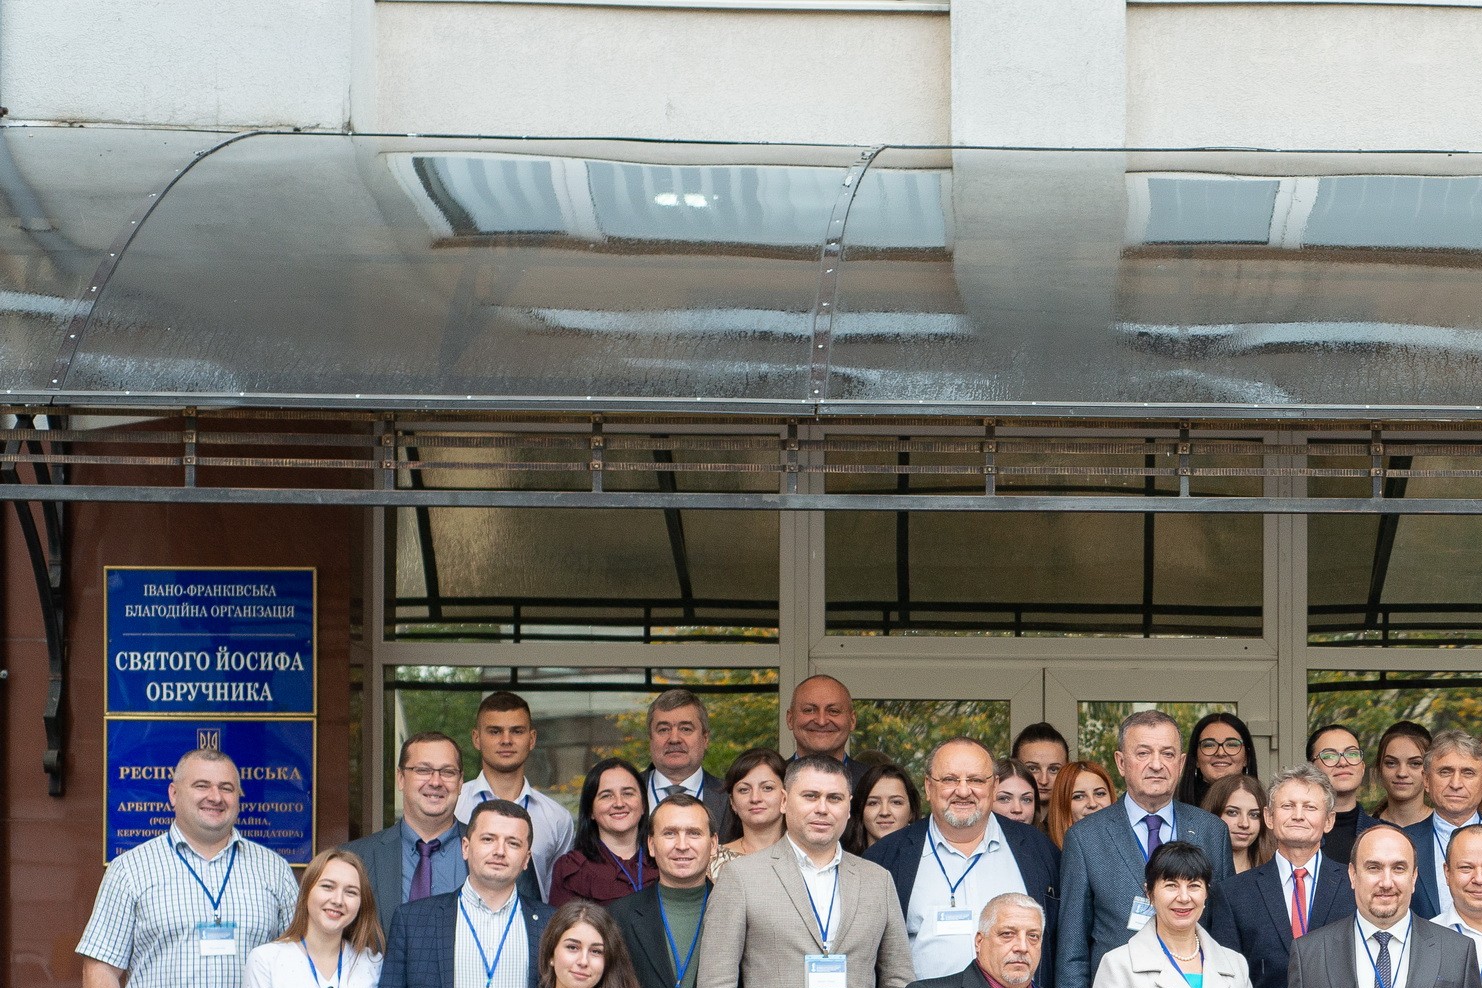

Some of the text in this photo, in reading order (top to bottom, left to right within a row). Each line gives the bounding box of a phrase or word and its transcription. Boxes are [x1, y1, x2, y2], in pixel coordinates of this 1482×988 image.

[143, 584, 277, 597] ІВАНО-ФРАНКІВСЬКА
[125, 603, 295, 619] БЛАГОДІЙНА ОРГАНІЗАЦІЯ
[115, 646, 304, 671] СВЯТОГО ЙОСИФА
[146, 682, 273, 702] ОБРУЧНИКА
